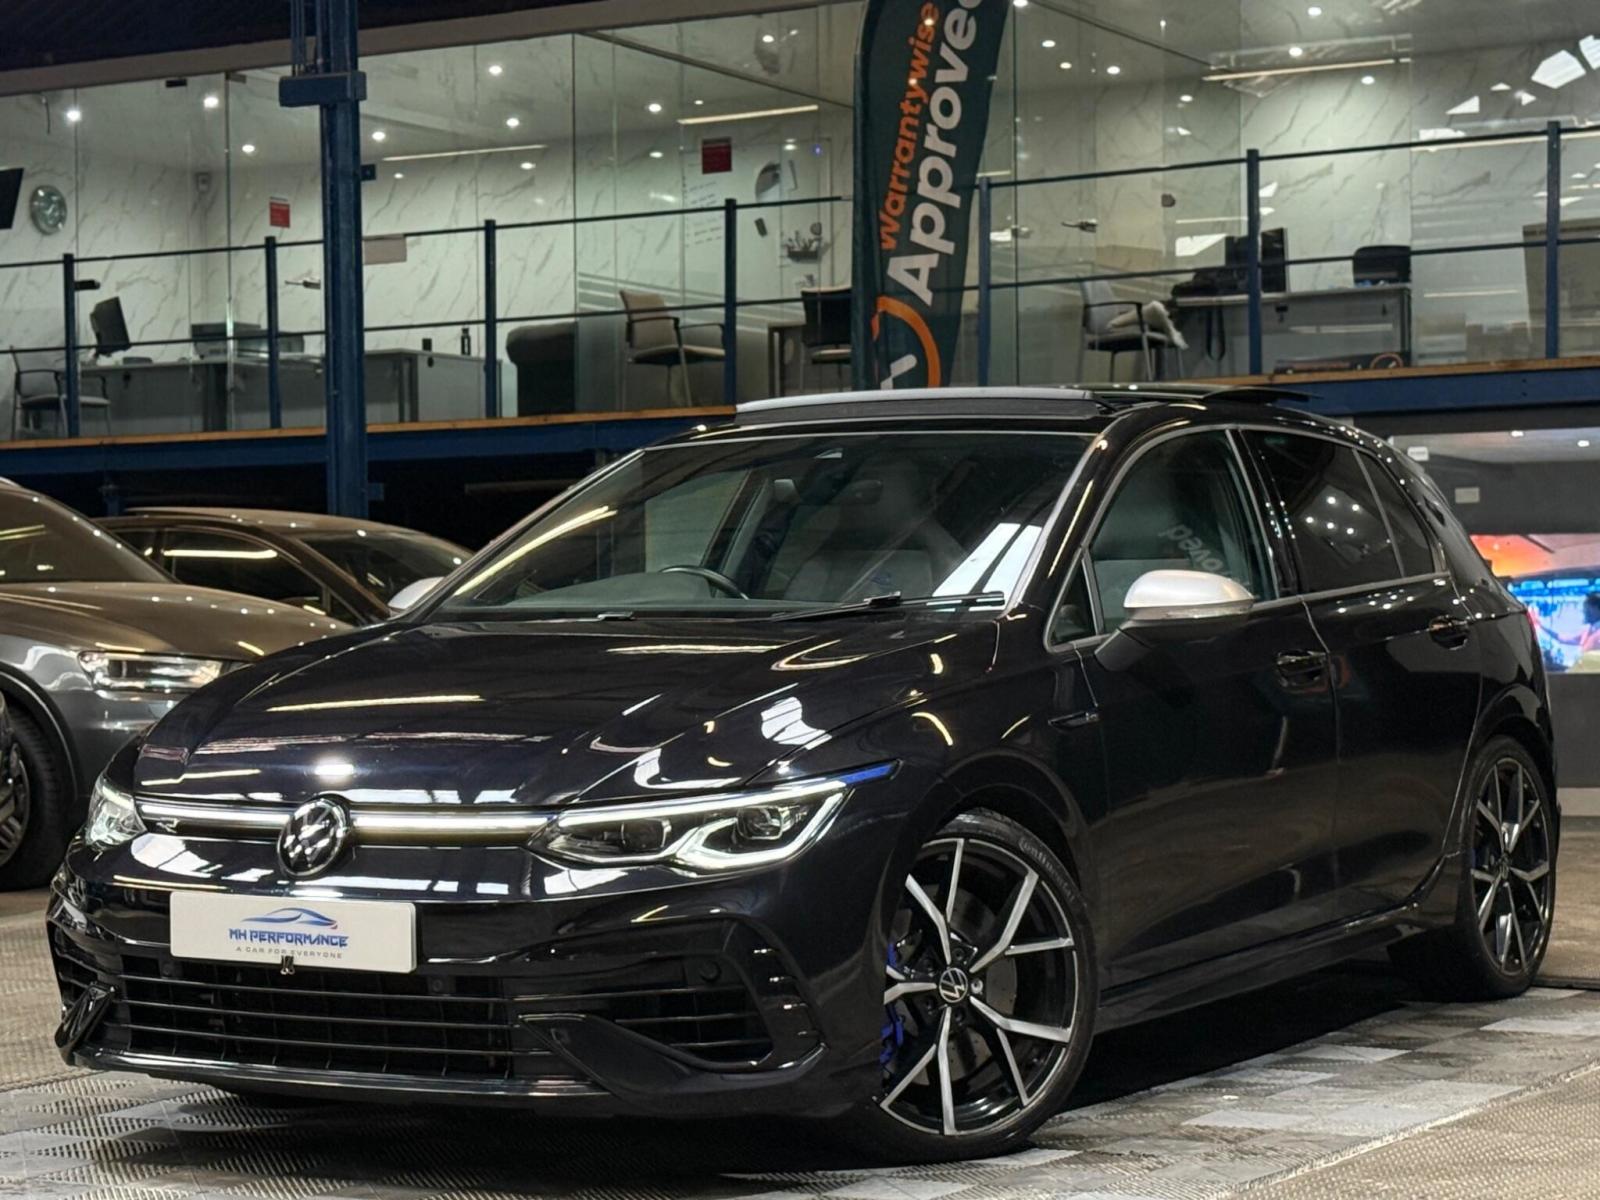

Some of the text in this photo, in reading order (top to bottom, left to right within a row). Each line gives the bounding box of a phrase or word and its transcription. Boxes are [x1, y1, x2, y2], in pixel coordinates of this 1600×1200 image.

[886, 0, 982, 307] Approve
[228, 928, 349, 948] MH PERFORMANCE
[290, 949, 342, 959] EVERYONE
